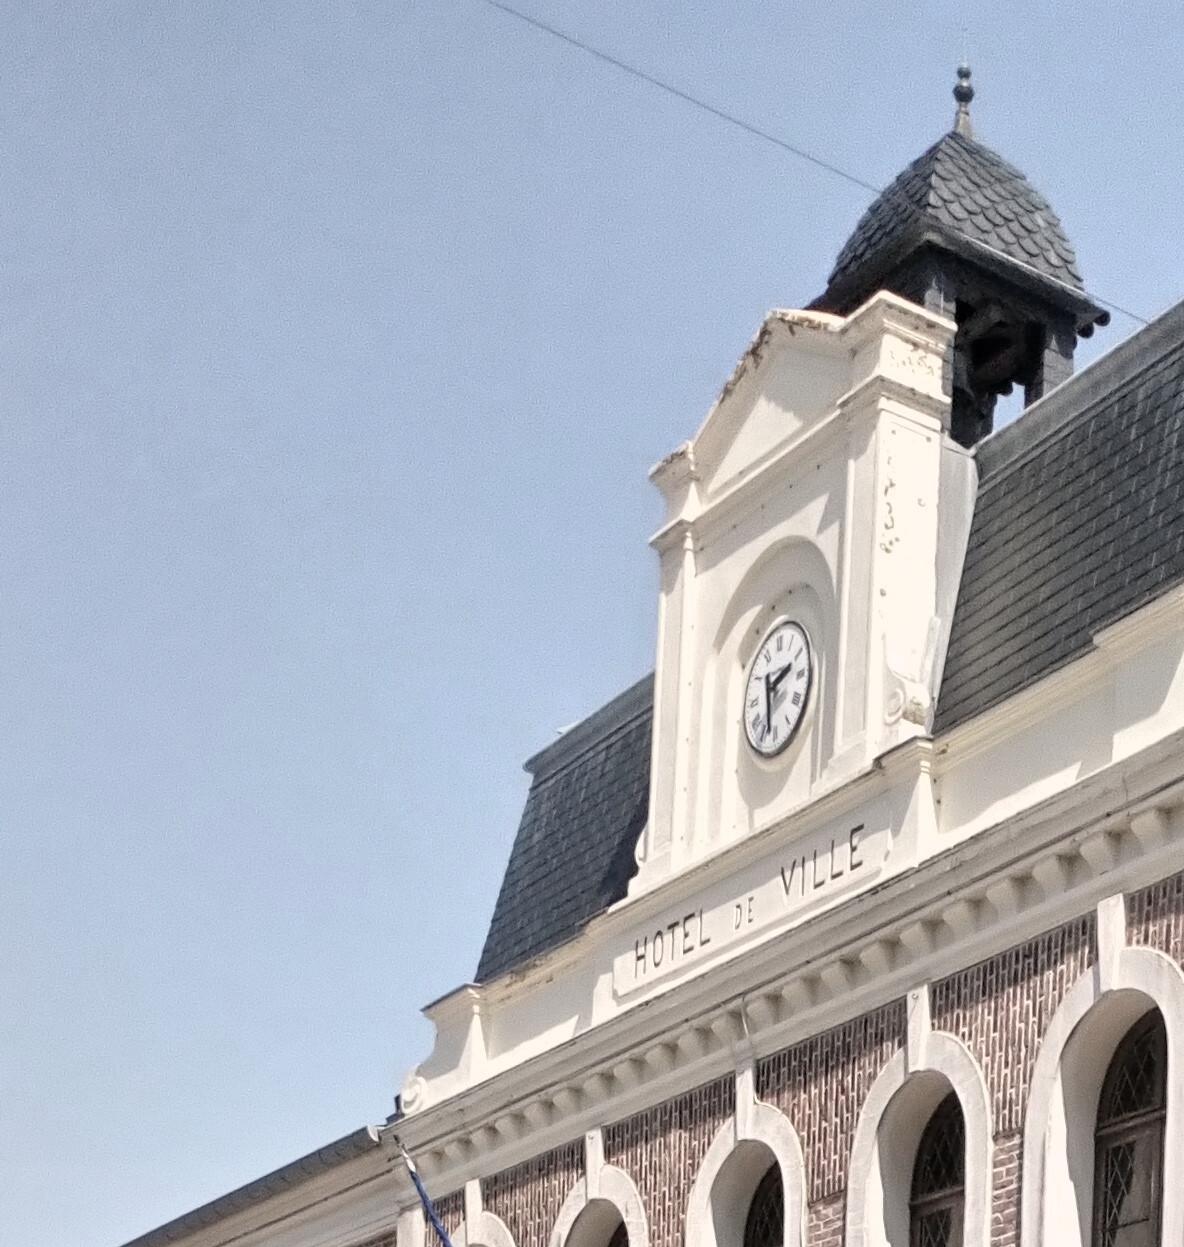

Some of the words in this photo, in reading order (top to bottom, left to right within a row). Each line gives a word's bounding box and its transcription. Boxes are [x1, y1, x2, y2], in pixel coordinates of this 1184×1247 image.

[634, 909, 711, 979] HOTEL
[733, 896, 754, 930] DE
[780, 823, 865, 897] VILLE
